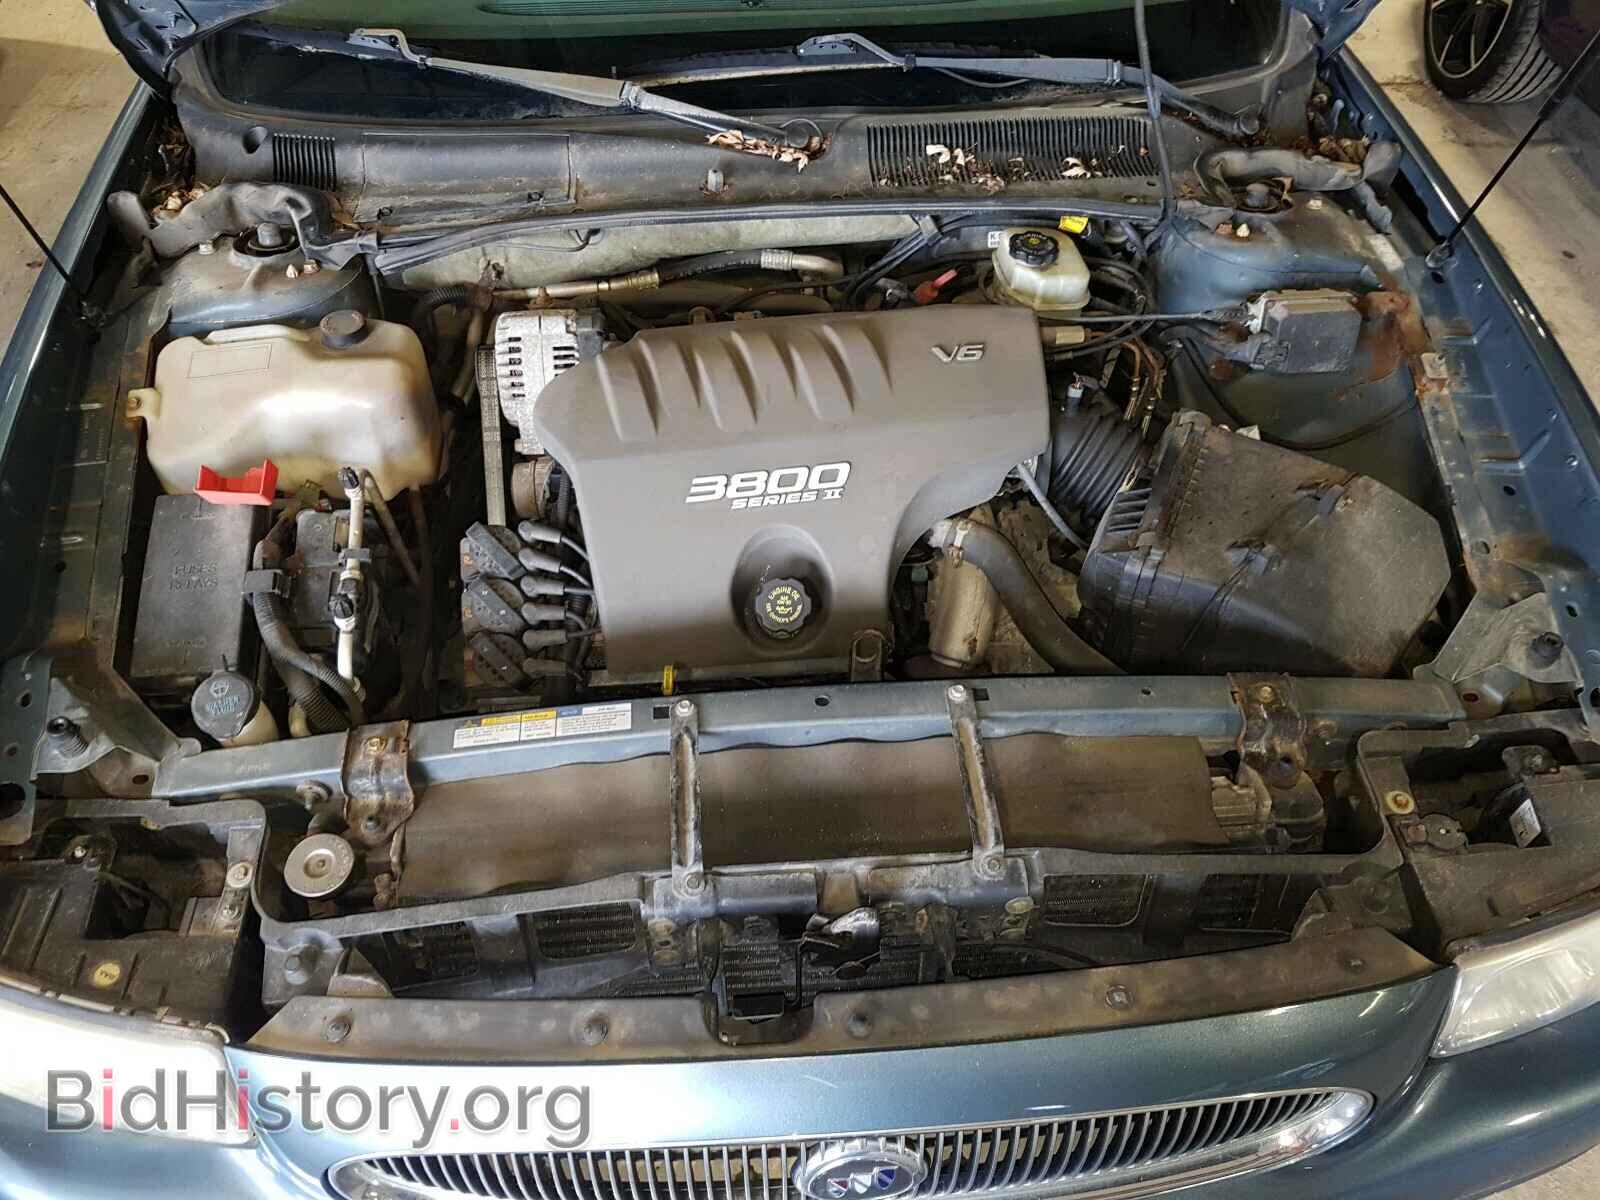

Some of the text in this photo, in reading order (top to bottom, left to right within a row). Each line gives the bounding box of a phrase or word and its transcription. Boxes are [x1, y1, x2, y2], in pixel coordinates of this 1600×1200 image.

[931, 344, 984, 362] V6
[685, 461, 851, 504] 3800
[731, 490, 818, 510] SERIES
